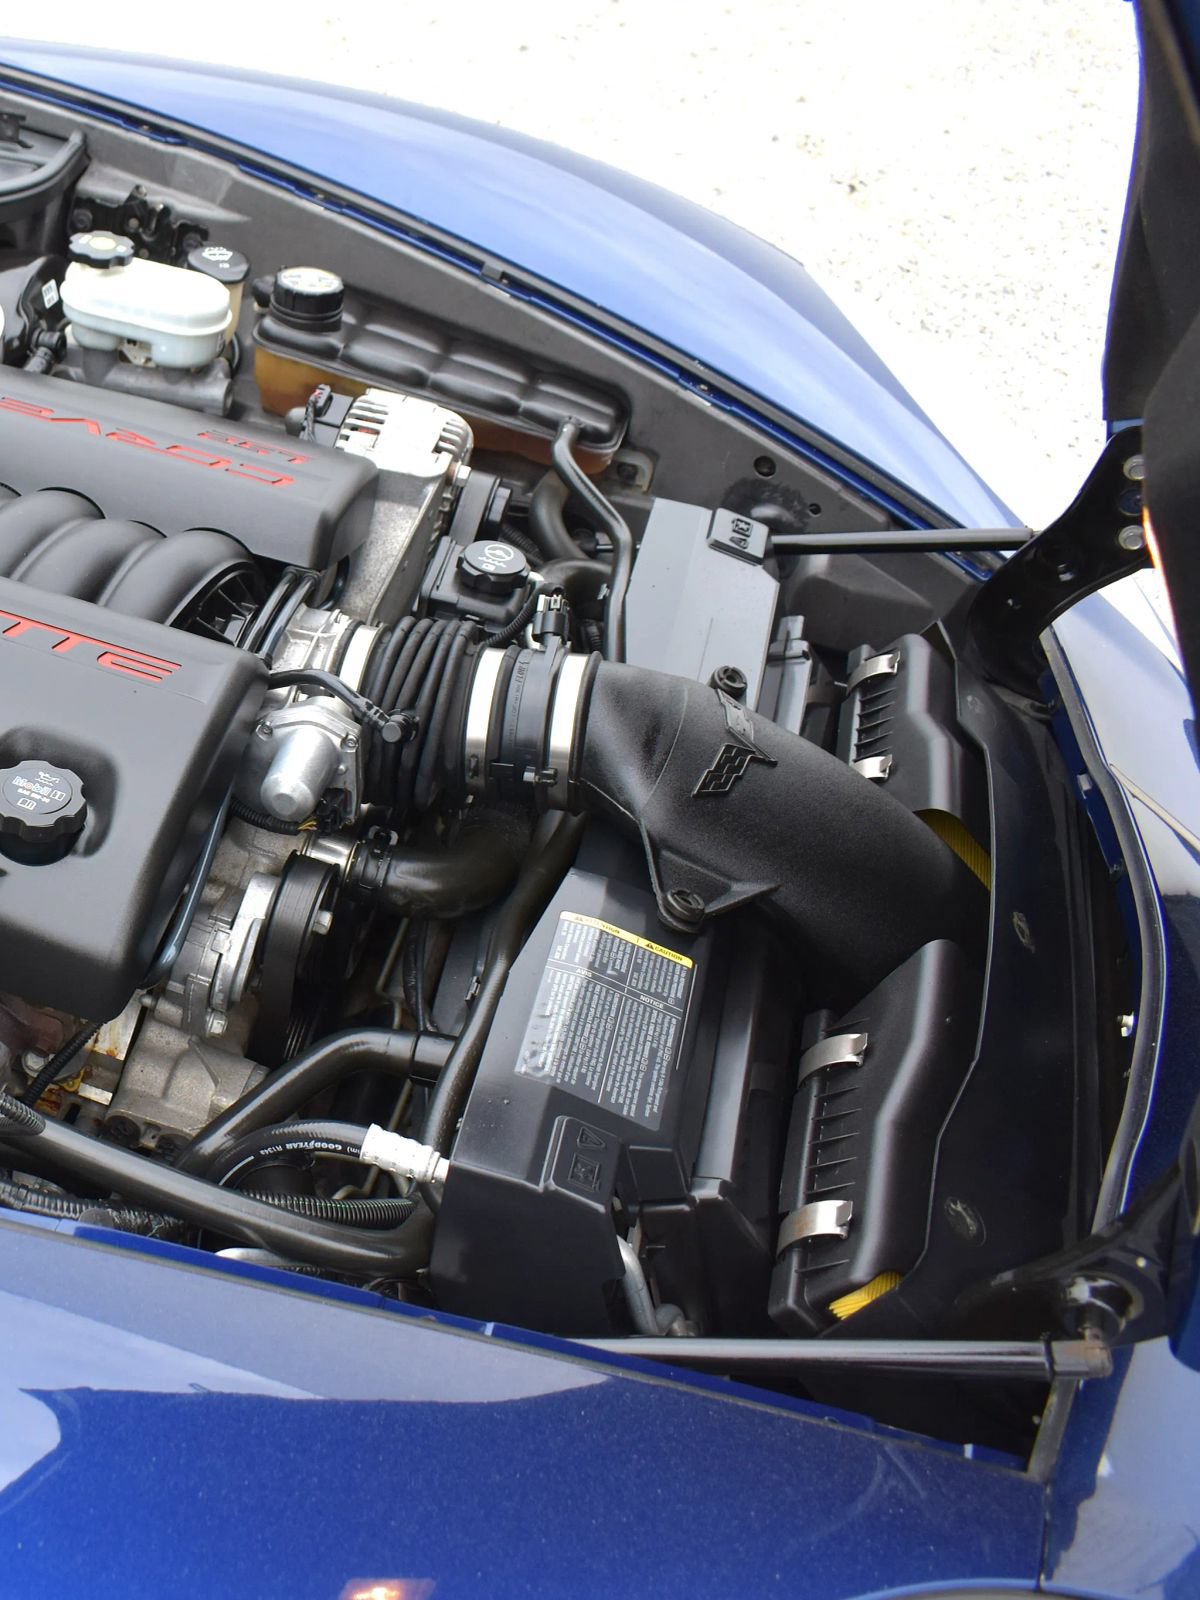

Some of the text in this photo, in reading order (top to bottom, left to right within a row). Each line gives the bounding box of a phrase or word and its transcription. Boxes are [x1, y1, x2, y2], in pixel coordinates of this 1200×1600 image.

[12, 776, 51, 796] Mobil
[654, 945, 683, 962] CAUTION
[576, 967, 593, 978] AVIS
[640, 994, 665, 1010] NOTICE
[258, 1144, 283, 1156] R134a
[285, 1139, 343, 1151] GOODYEAR
